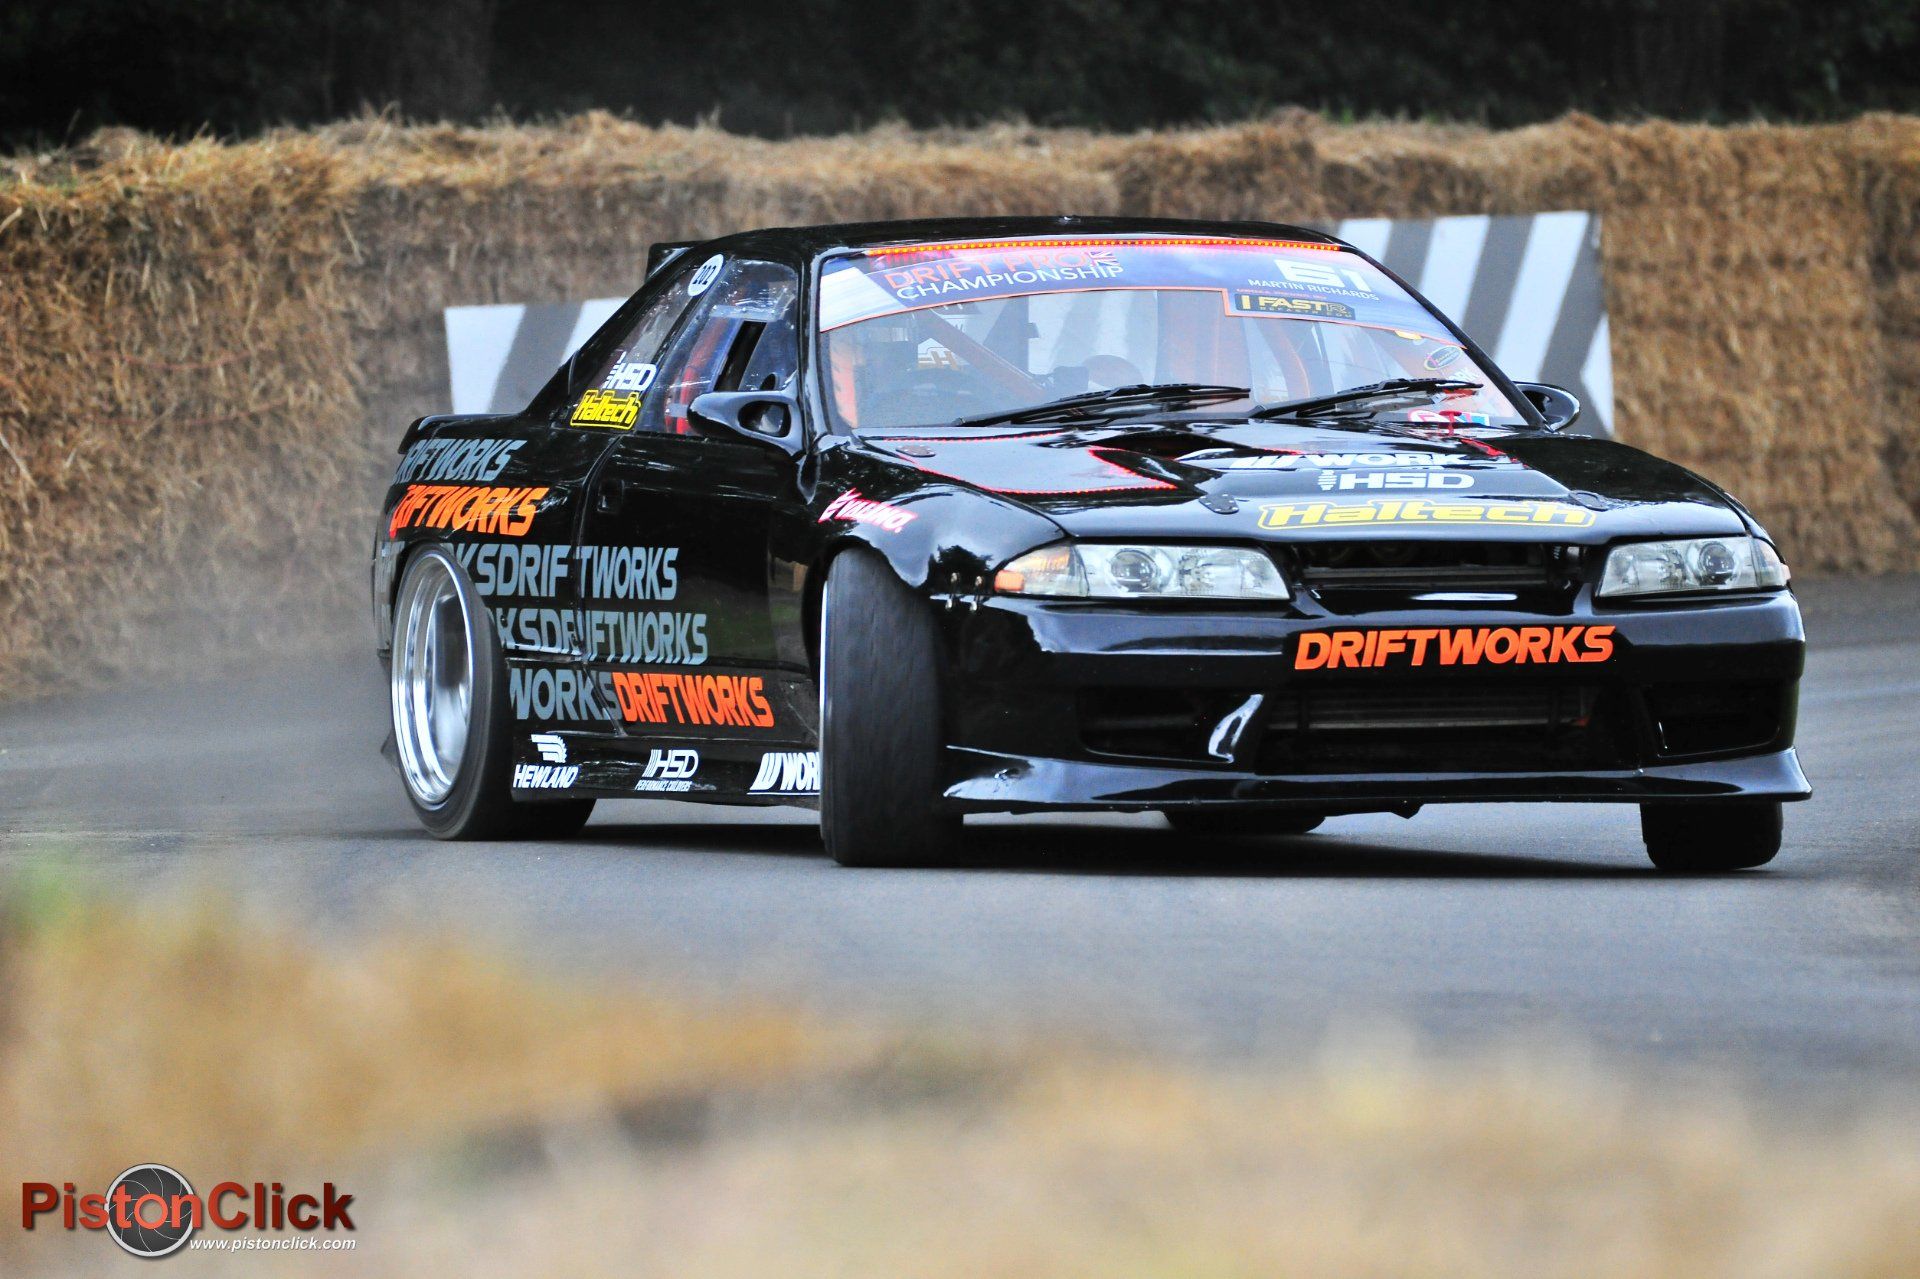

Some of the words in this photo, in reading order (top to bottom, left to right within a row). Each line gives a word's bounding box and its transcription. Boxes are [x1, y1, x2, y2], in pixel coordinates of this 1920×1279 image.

[884, 257, 993, 290] DRIFT
[1003, 250, 1090, 272] PRO
[896, 265, 1124, 300] CHAMPIONSHIP
[1248, 279, 1303, 291] MARTIN
[1309, 284, 1380, 301] RICHARDS
[573, 394, 639, 424] Haltech
[1303, 454, 1472, 467] WORK
[1339, 473, 1474, 490] HSD
[1270, 502, 1586, 527] Haltech
[1295, 626, 1617, 670] DRIFTWORKS
[612, 672, 775, 727] DRIFTWORKS
[513, 764, 579, 788] HEWLAND
